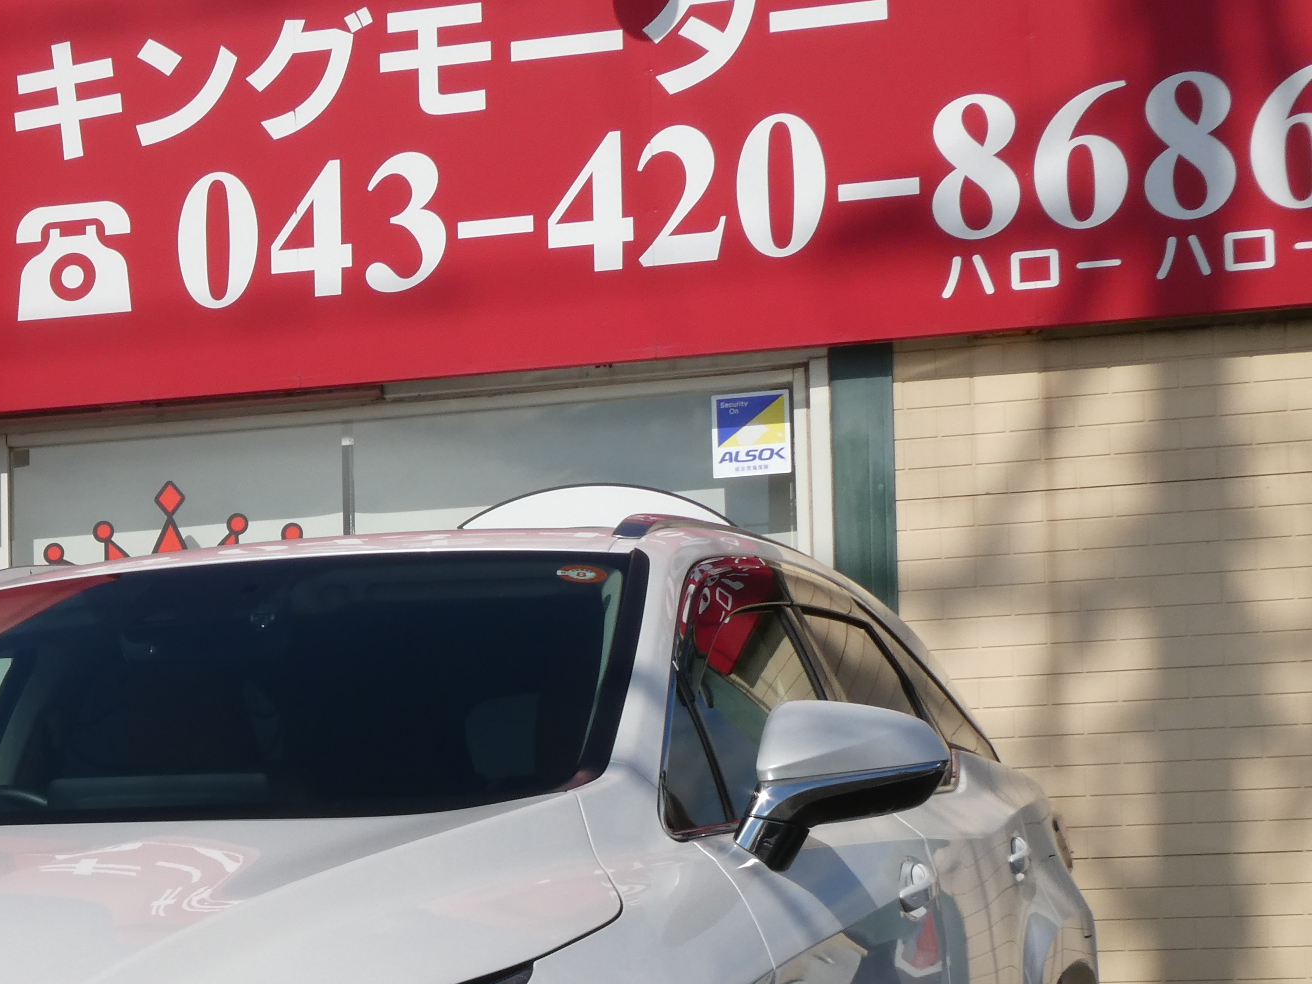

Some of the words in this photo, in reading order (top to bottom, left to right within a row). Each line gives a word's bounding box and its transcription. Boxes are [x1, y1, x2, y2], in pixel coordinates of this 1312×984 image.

[14, 0, 888, 161] キングモーター
[177, 64, 1312, 309] 043-420-8686
[941, 249, 1121, 299] ハロー
[720, 401, 748, 409] Security
[718, 446, 786, 464] ALSOK
